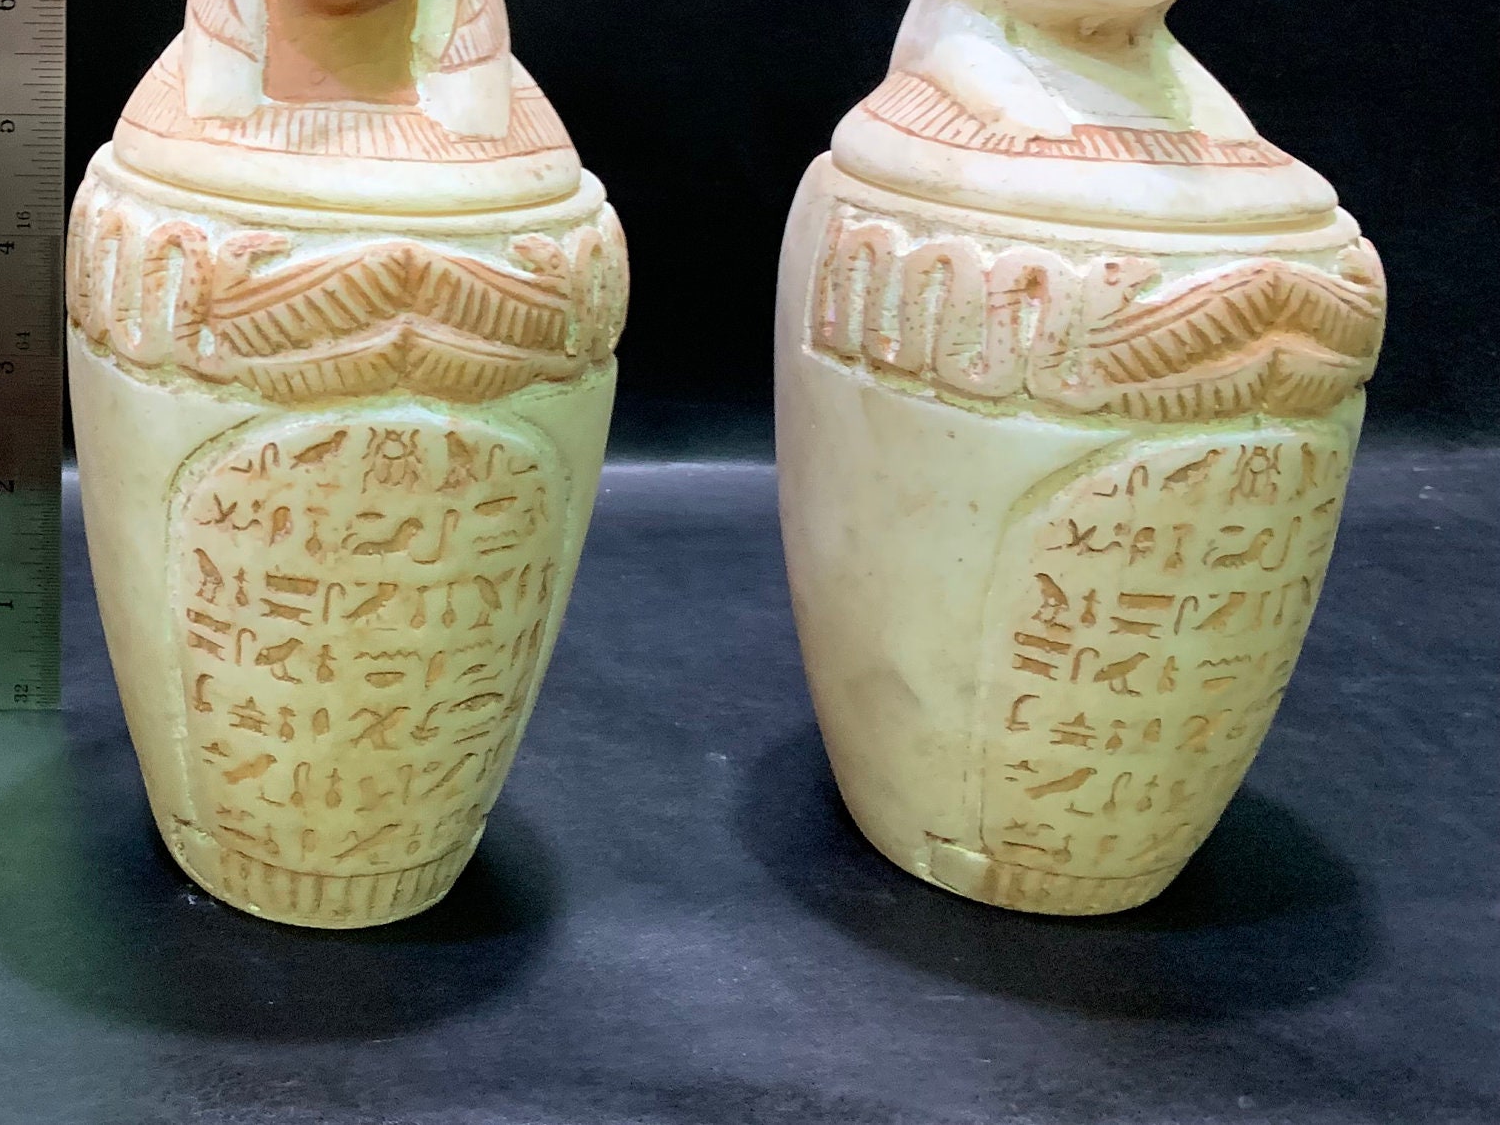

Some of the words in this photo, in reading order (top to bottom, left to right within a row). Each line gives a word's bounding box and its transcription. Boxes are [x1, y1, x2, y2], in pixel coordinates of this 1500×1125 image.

[15, 210, 32, 230] 16
[15, 331, 31, 351] 64
[13, 683, 29, 704] 32
